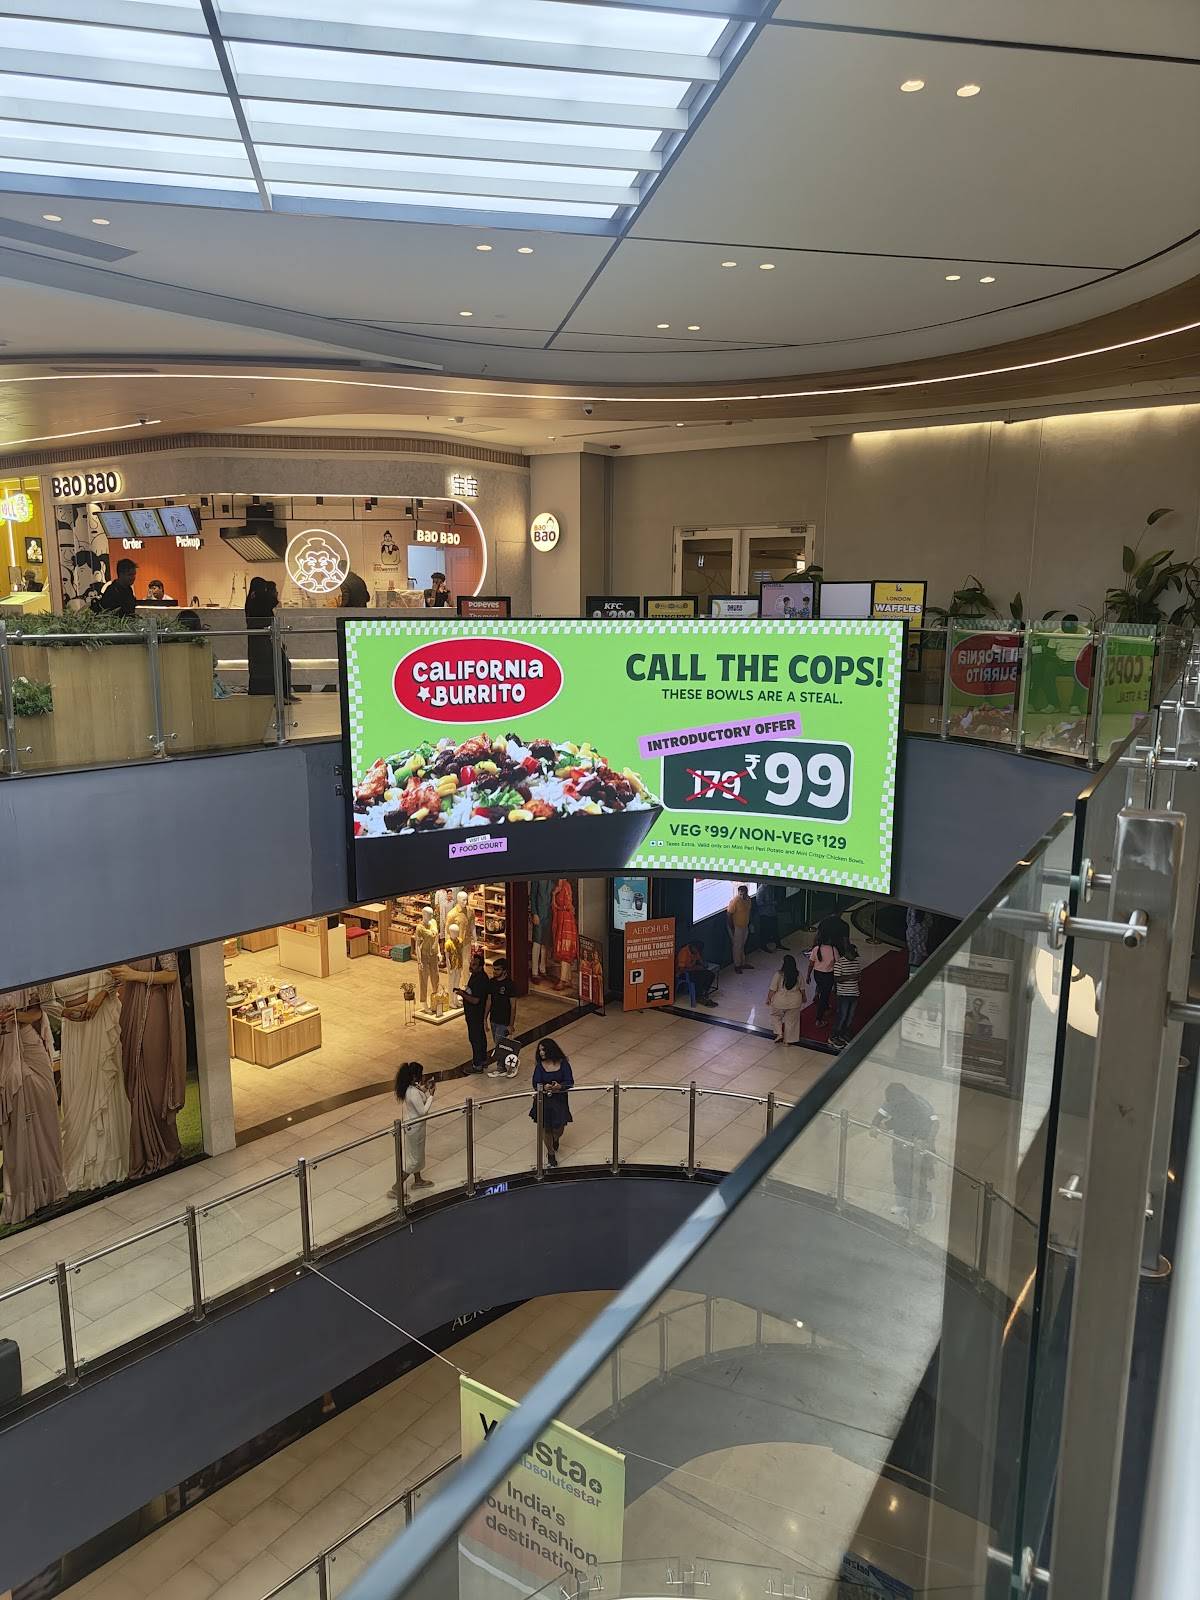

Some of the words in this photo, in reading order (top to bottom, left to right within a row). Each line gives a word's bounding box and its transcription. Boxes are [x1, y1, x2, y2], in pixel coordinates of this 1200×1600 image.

[122, 538, 143, 550] Order
[176, 536, 200, 550] Pickup
[604, 602, 623, 610] KFC
[874, 603, 921, 613] WAFFLES
[625, 653, 706, 682] CALL
[716, 653, 779, 683] THE
[788, 654, 884, 688] COPS!
[430, 683, 526, 707] BURRITO
[661, 688, 702, 700] THESE
[706, 689, 754, 701] BOWLS
[757, 690, 783, 702] ARE
[786, 691, 796, 702] A
[799, 692, 843, 705] STEAL.
[647, 725, 751, 752] INTRODUCTORY
[755, 719, 797, 735] OFFER
[669, 823, 702, 836] VEG
[459, 844, 478, 853] FOOD
[479, 842, 503, 850] COURT
[808, 851, 825, 859] Crispy
[826, 853, 848, 862] Chicken
[632, 970, 642, 983] P
[507, 1480, 566, 1527] India's
[530, 1515, 598, 1568] fashion
